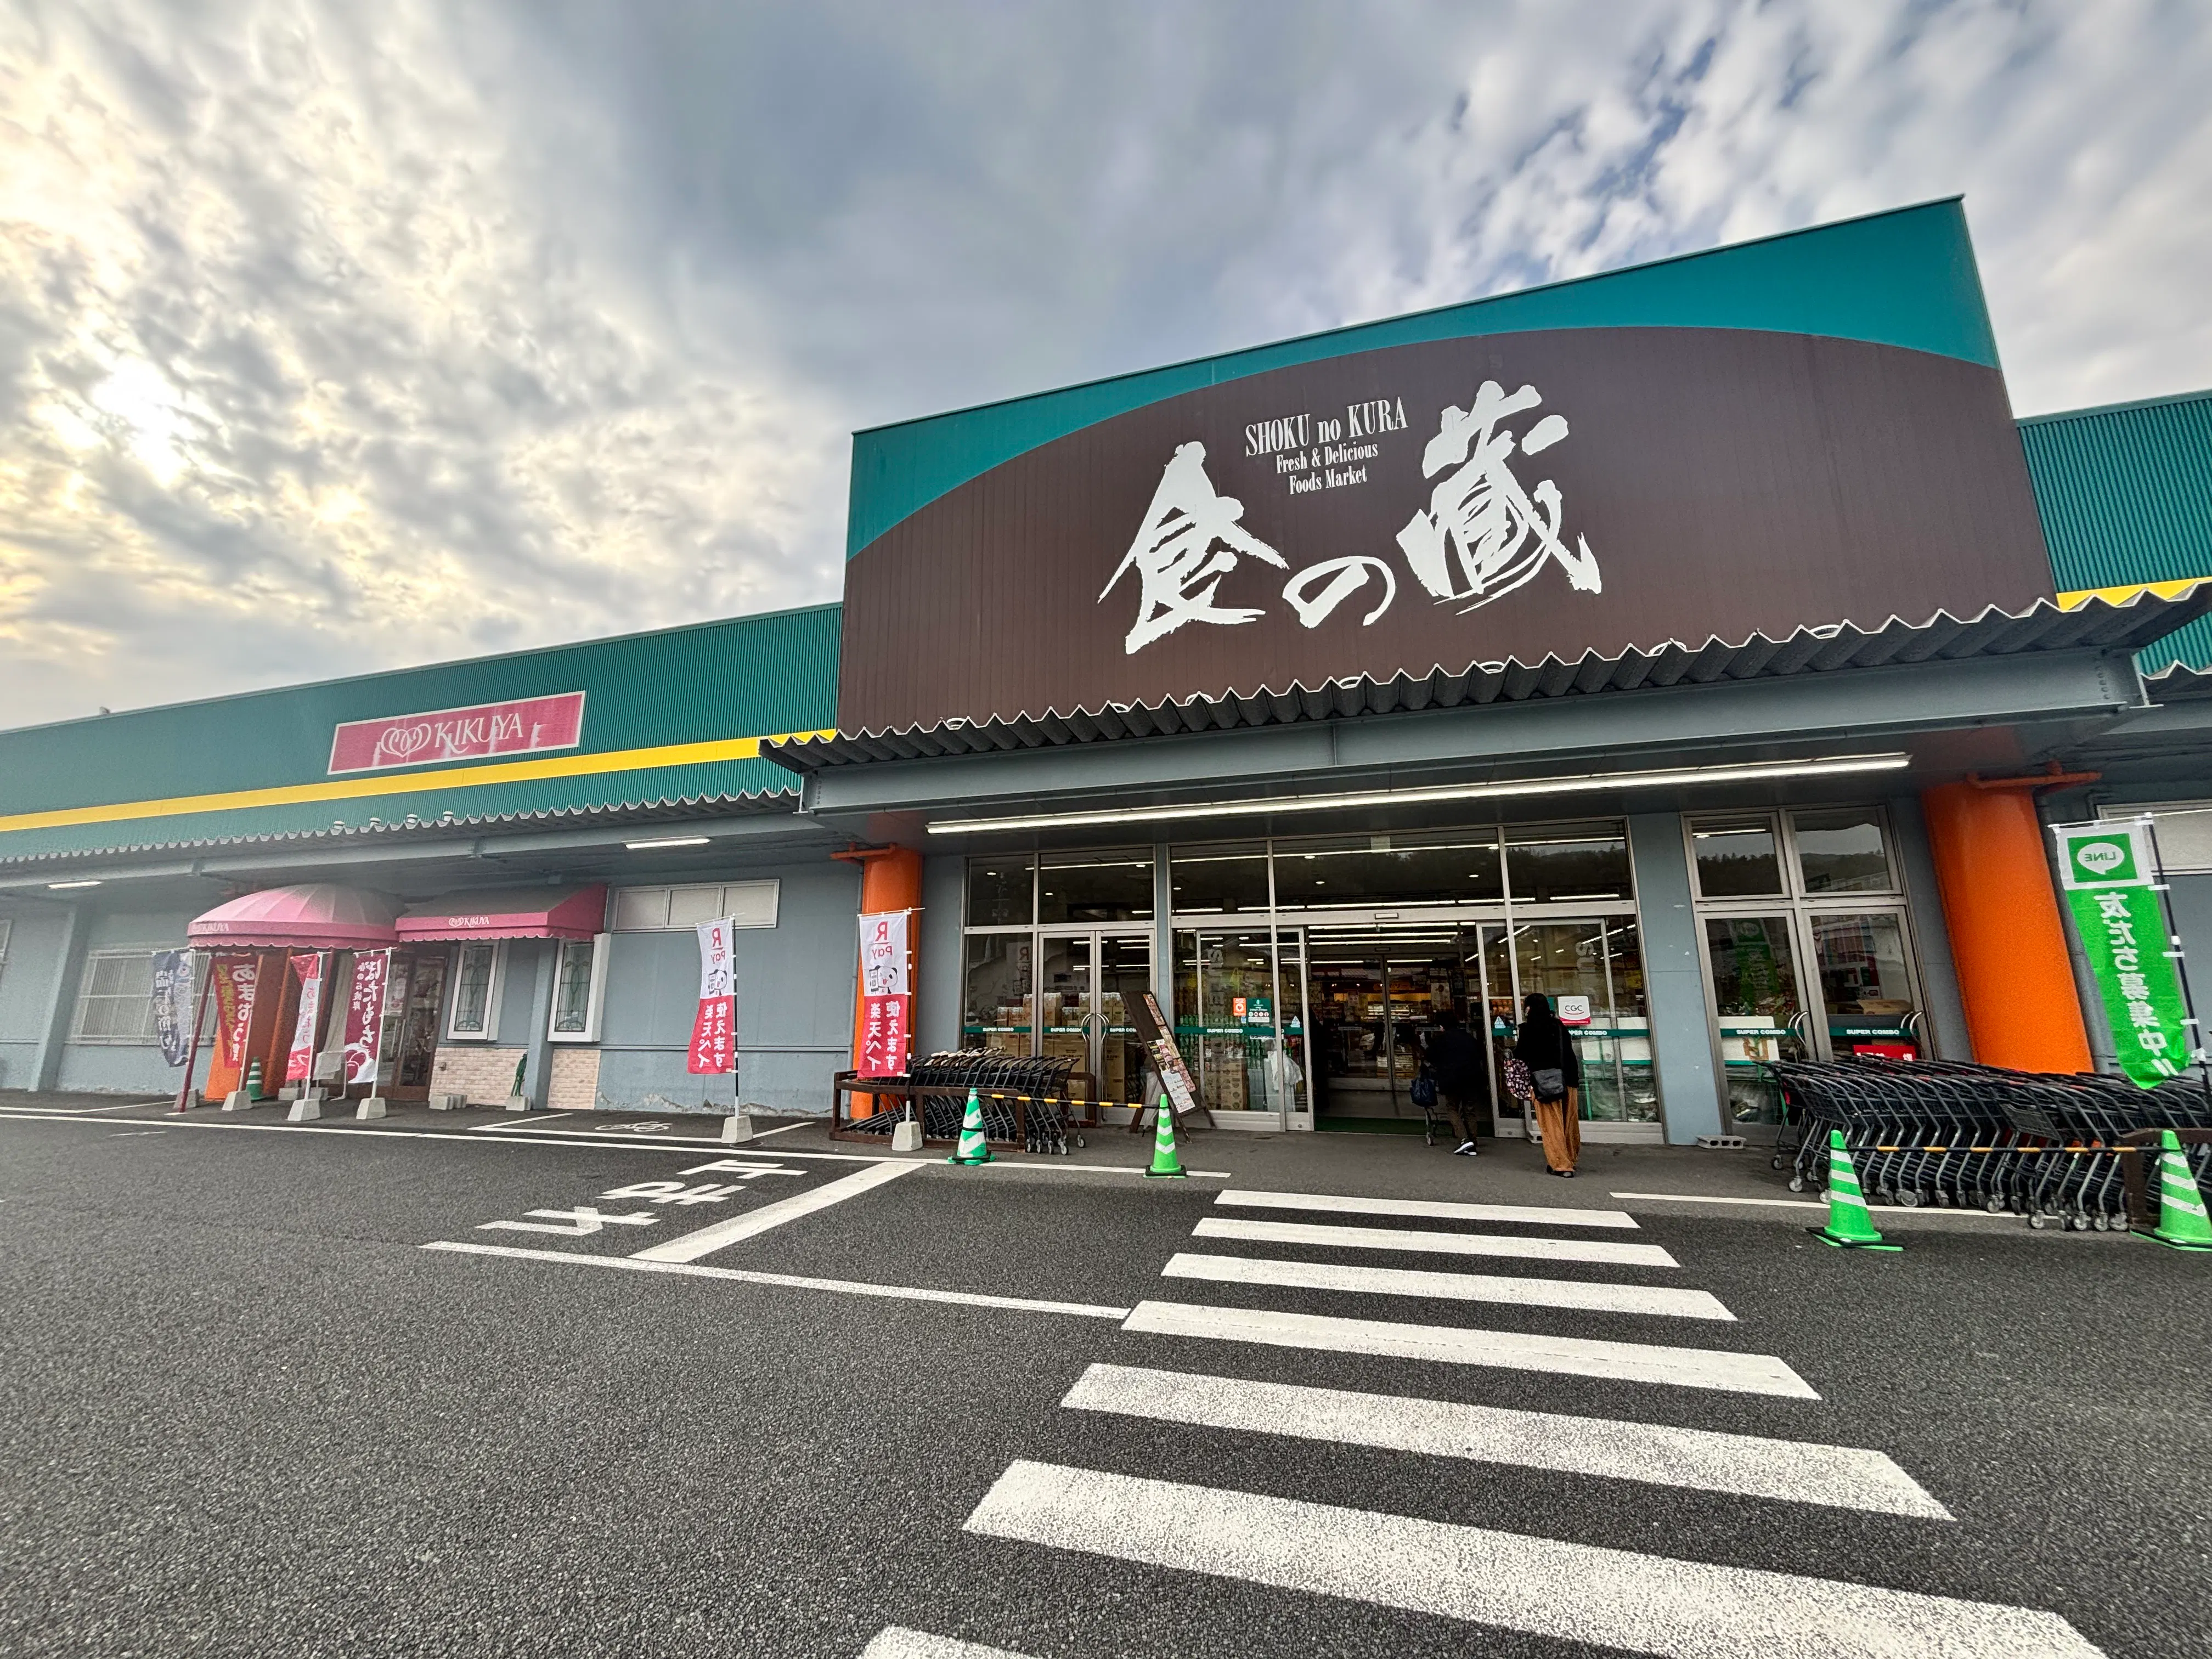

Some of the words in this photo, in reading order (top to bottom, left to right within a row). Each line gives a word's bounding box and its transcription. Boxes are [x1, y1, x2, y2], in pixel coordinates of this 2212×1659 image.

[1245, 413, 1311, 457] SHOKU
[1317, 418, 1341, 443] no
[1347, 397, 1408, 438] KURA
[1276, 450, 1308, 474] Fresh
[1311, 448, 1321, 467] &
[1324, 441, 1378, 465] Delicious
[1289, 472, 1322, 495] Foods
[1325, 464, 1367, 489] Market
[1097, 380, 1601, 654] 食の蔵
[434, 713, 523, 754] KIKUYA
[464, 917, 489, 928] KIKUYA
